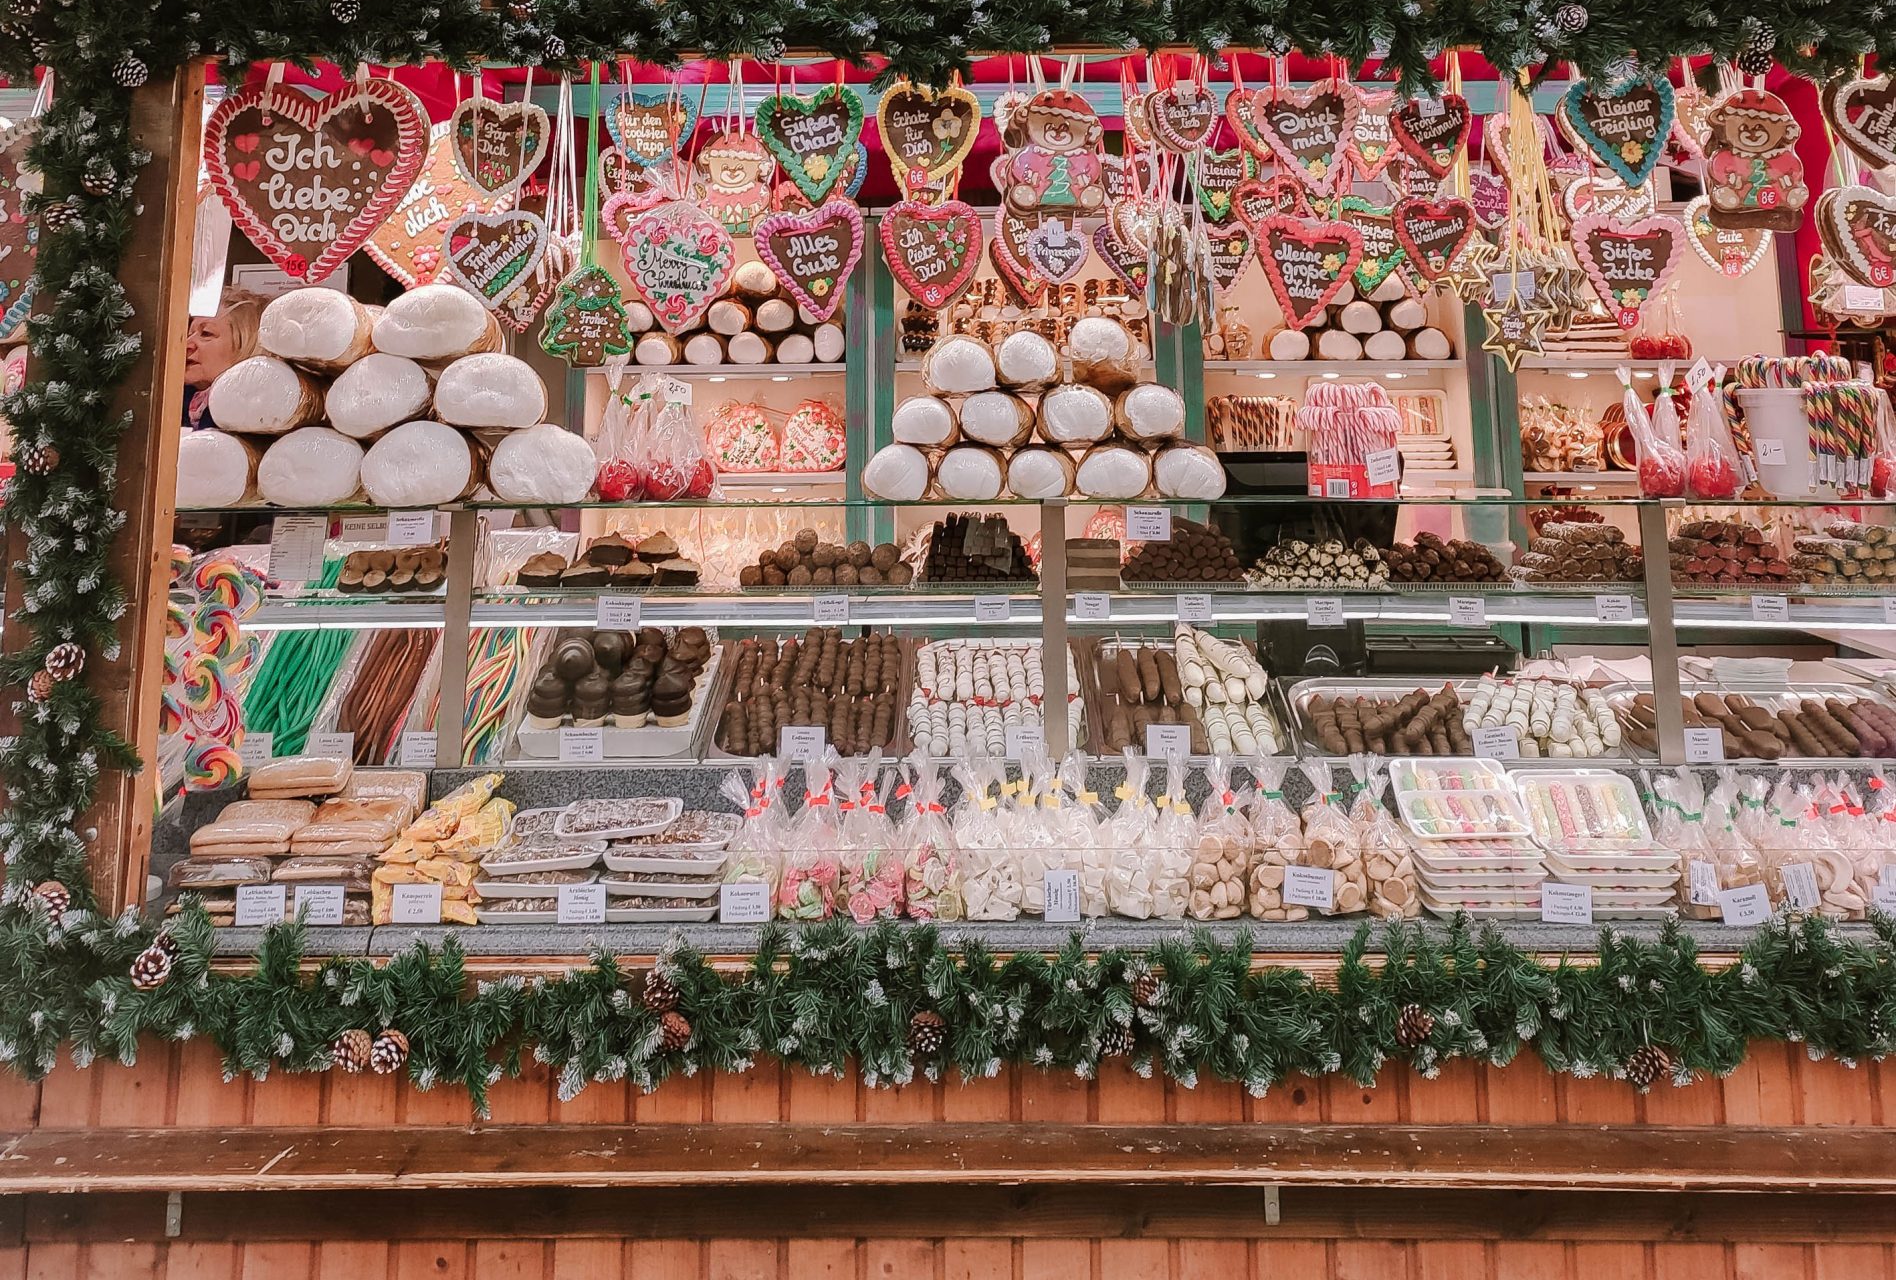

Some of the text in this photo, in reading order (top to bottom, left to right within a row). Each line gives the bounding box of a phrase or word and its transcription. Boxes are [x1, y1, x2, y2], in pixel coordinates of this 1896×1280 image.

[1594, 99, 1652, 118] Kleiner
[643, 112, 662, 125] den
[781, 113, 839, 136] Süßer
[893, 111, 930, 128] Schatz
[1272, 107, 1339, 134] Drück
[1412, 109, 1462, 144] Weihnacht
[1591, 115, 1656, 141] Feigling
[625, 126, 667, 139] coolsten
[905, 127, 923, 142] für
[1292, 125, 1337, 151] mich
[266, 132, 341, 171] Ich
[636, 138, 664, 156] Papa
[903, 141, 932, 157] Dich
[910, 171, 924, 184] 6€
[1761, 192, 1774, 204] 8€
[272, 210, 337, 242] Dich
[405, 197, 449, 237] dich
[1406, 220, 1436, 234] Frohe
[1413, 218, 1464, 245] Weihnacht
[787, 234, 838, 258] Alles
[901, 227, 924, 247] Ich
[1716, 232, 1744, 243] Gute
[908, 244, 938, 265] liebe
[1275, 243, 1322, 264] Meine
[1364, 240, 1394, 256] eger
[1600, 241, 1655, 269] Süße
[470, 229, 537, 288] Weihnachten
[793, 255, 840, 277] Gute
[915, 258, 947, 282] Dich
[1283, 262, 1329, 286] große
[1602, 263, 1657, 281] Zicke
[1726, 263, 1738, 274] 6€
[1874, 266, 1889, 280] 6€
[643, 269, 707, 291] Christmas
[924, 288, 941, 302] 6€
[1622, 312, 1635, 325] 6€
[581, 325, 602, 338] Fest
[668, 382, 687, 395] 2,50
[344, 523, 365, 531] KEINE
